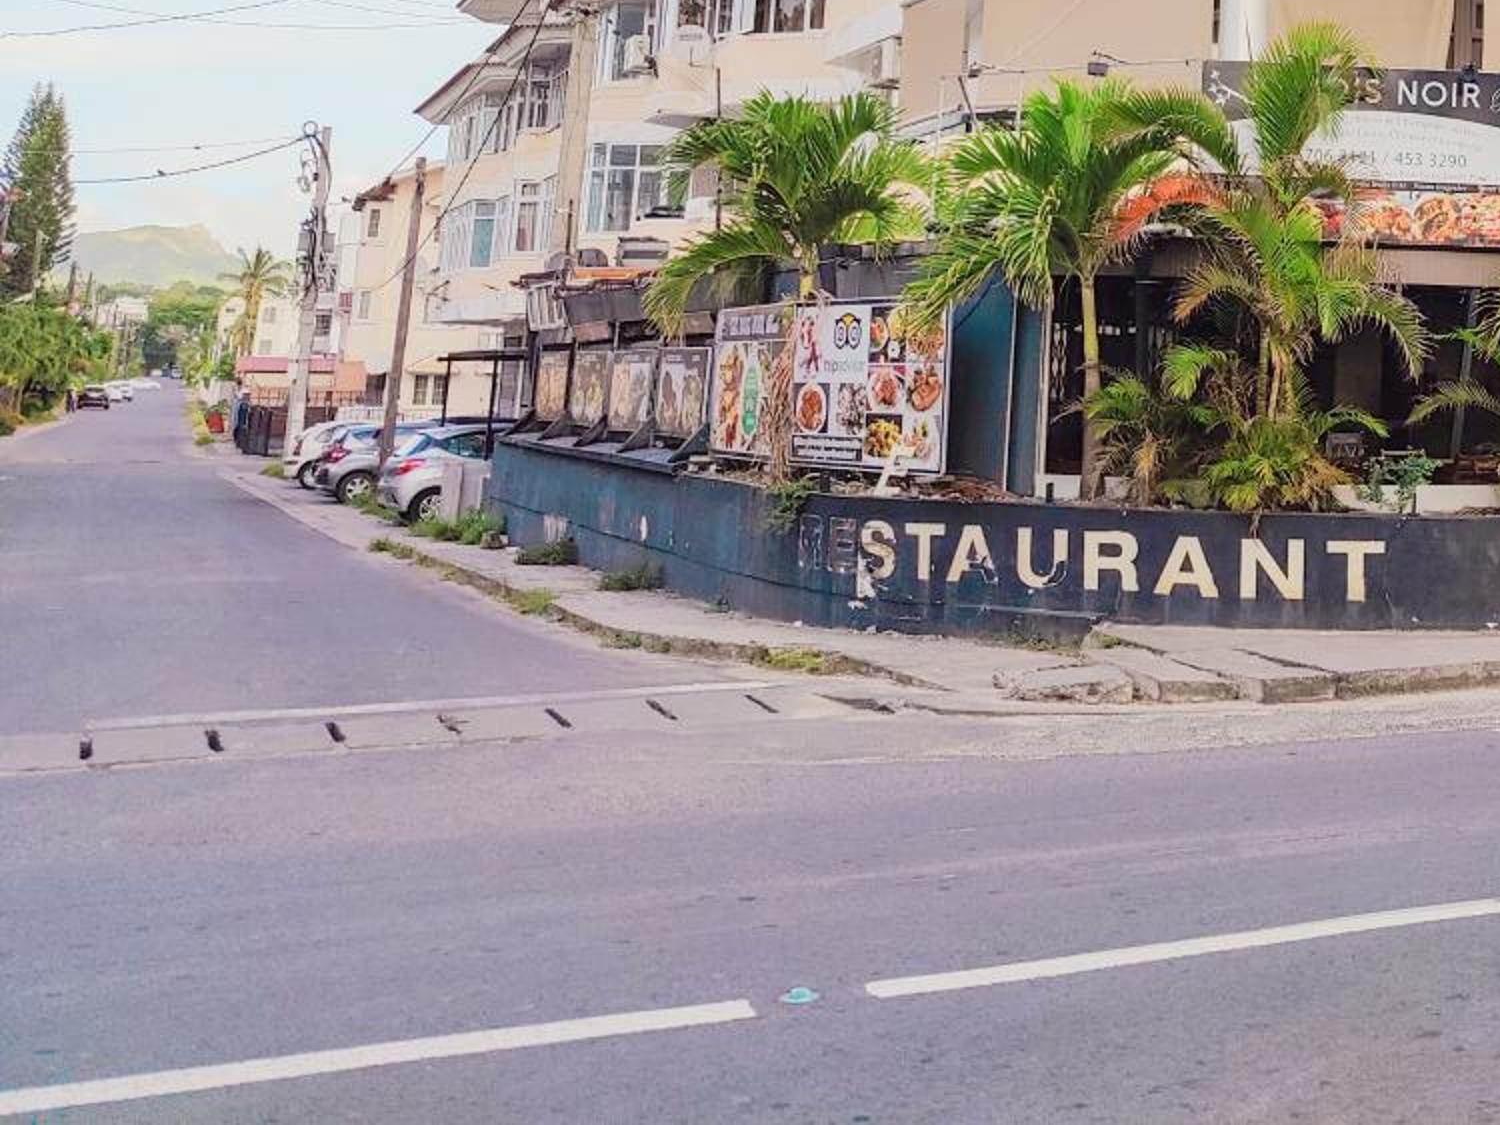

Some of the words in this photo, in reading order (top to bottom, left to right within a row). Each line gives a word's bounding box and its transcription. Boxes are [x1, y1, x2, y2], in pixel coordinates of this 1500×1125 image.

[1396, 78, 1481, 109] NOIR
[1394, 151, 1424, 166] 453
[1429, 153, 1468, 168] 3290
